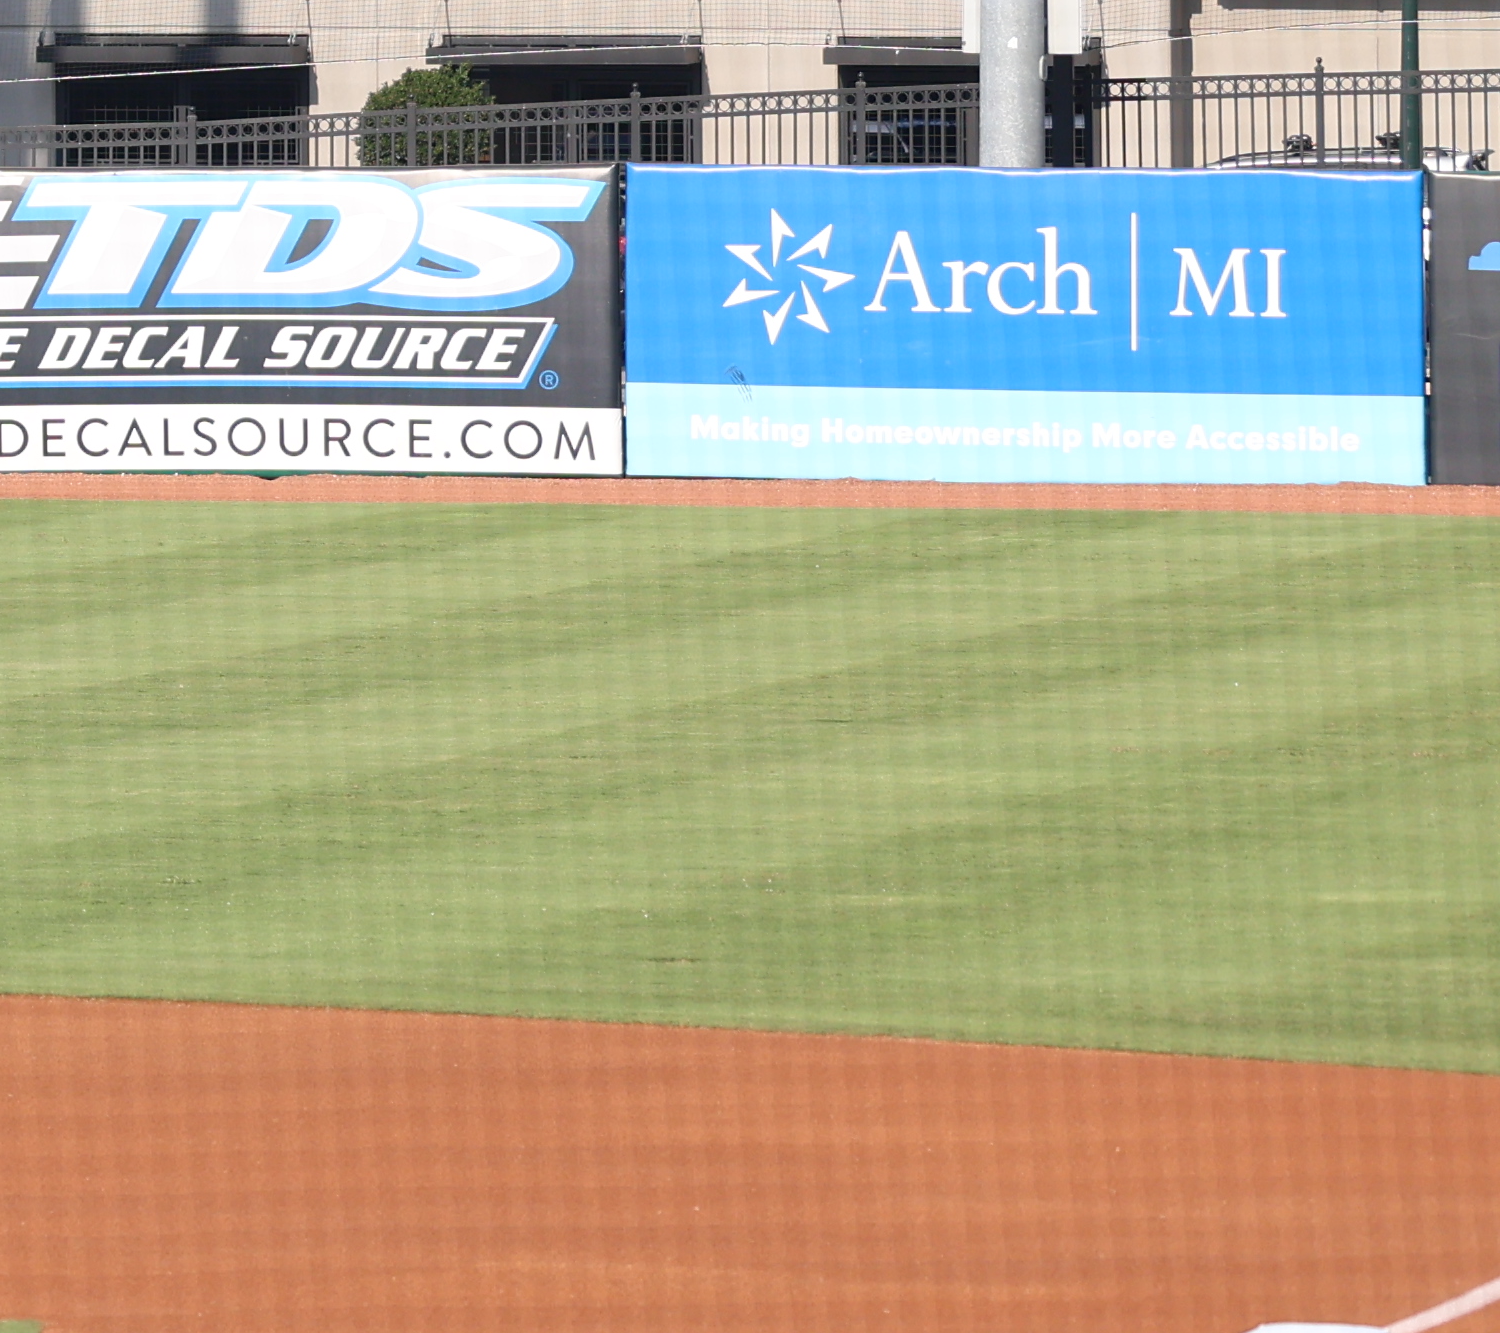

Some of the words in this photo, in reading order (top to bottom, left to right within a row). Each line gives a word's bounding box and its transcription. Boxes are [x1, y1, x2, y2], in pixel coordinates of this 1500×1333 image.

[12, 175, 606, 311] TDS
[864, 227, 1098, 315] Arch
[1169, 248, 1287, 319] MI
[37, 326, 243, 371] DECAL
[263, 327, 527, 372] SOURCE
[690, 415, 810, 448] Making
[822, 417, 1082, 453] Homeownership
[1092, 422, 1177, 450] More
[1185, 424, 1360, 453] Accessible
